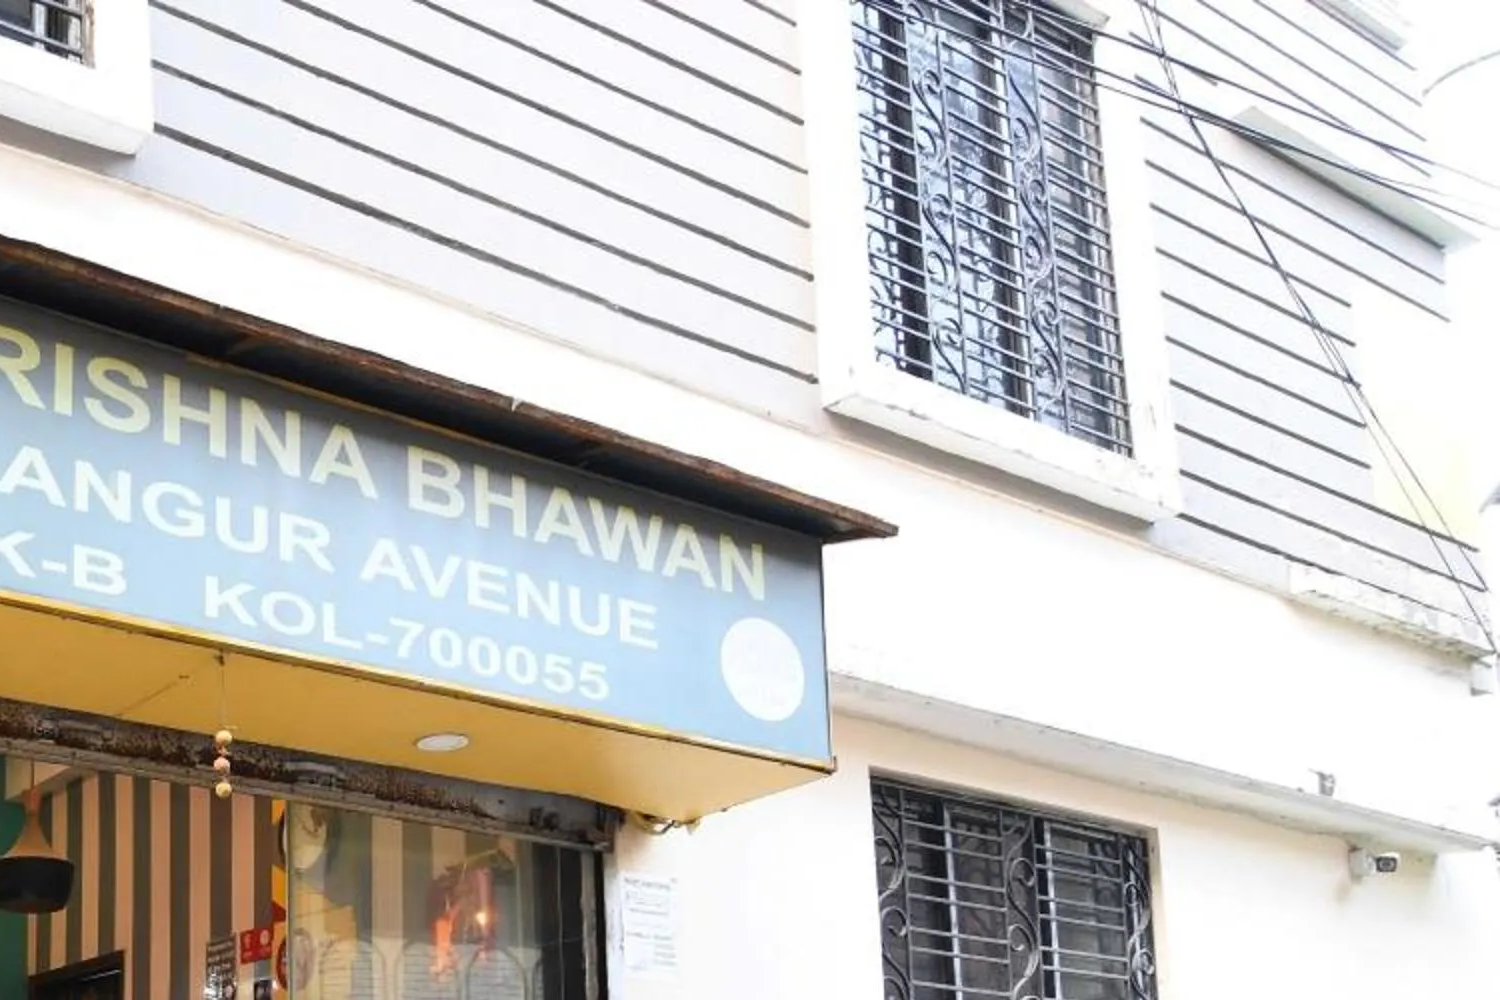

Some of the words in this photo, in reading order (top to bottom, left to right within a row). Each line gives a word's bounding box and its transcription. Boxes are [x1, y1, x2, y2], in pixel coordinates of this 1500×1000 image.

[407, 444, 768, 602] BHAWAN
[202, 575, 611, 702] KOL-700055
[361, 537, 660, 652] AVENUE
